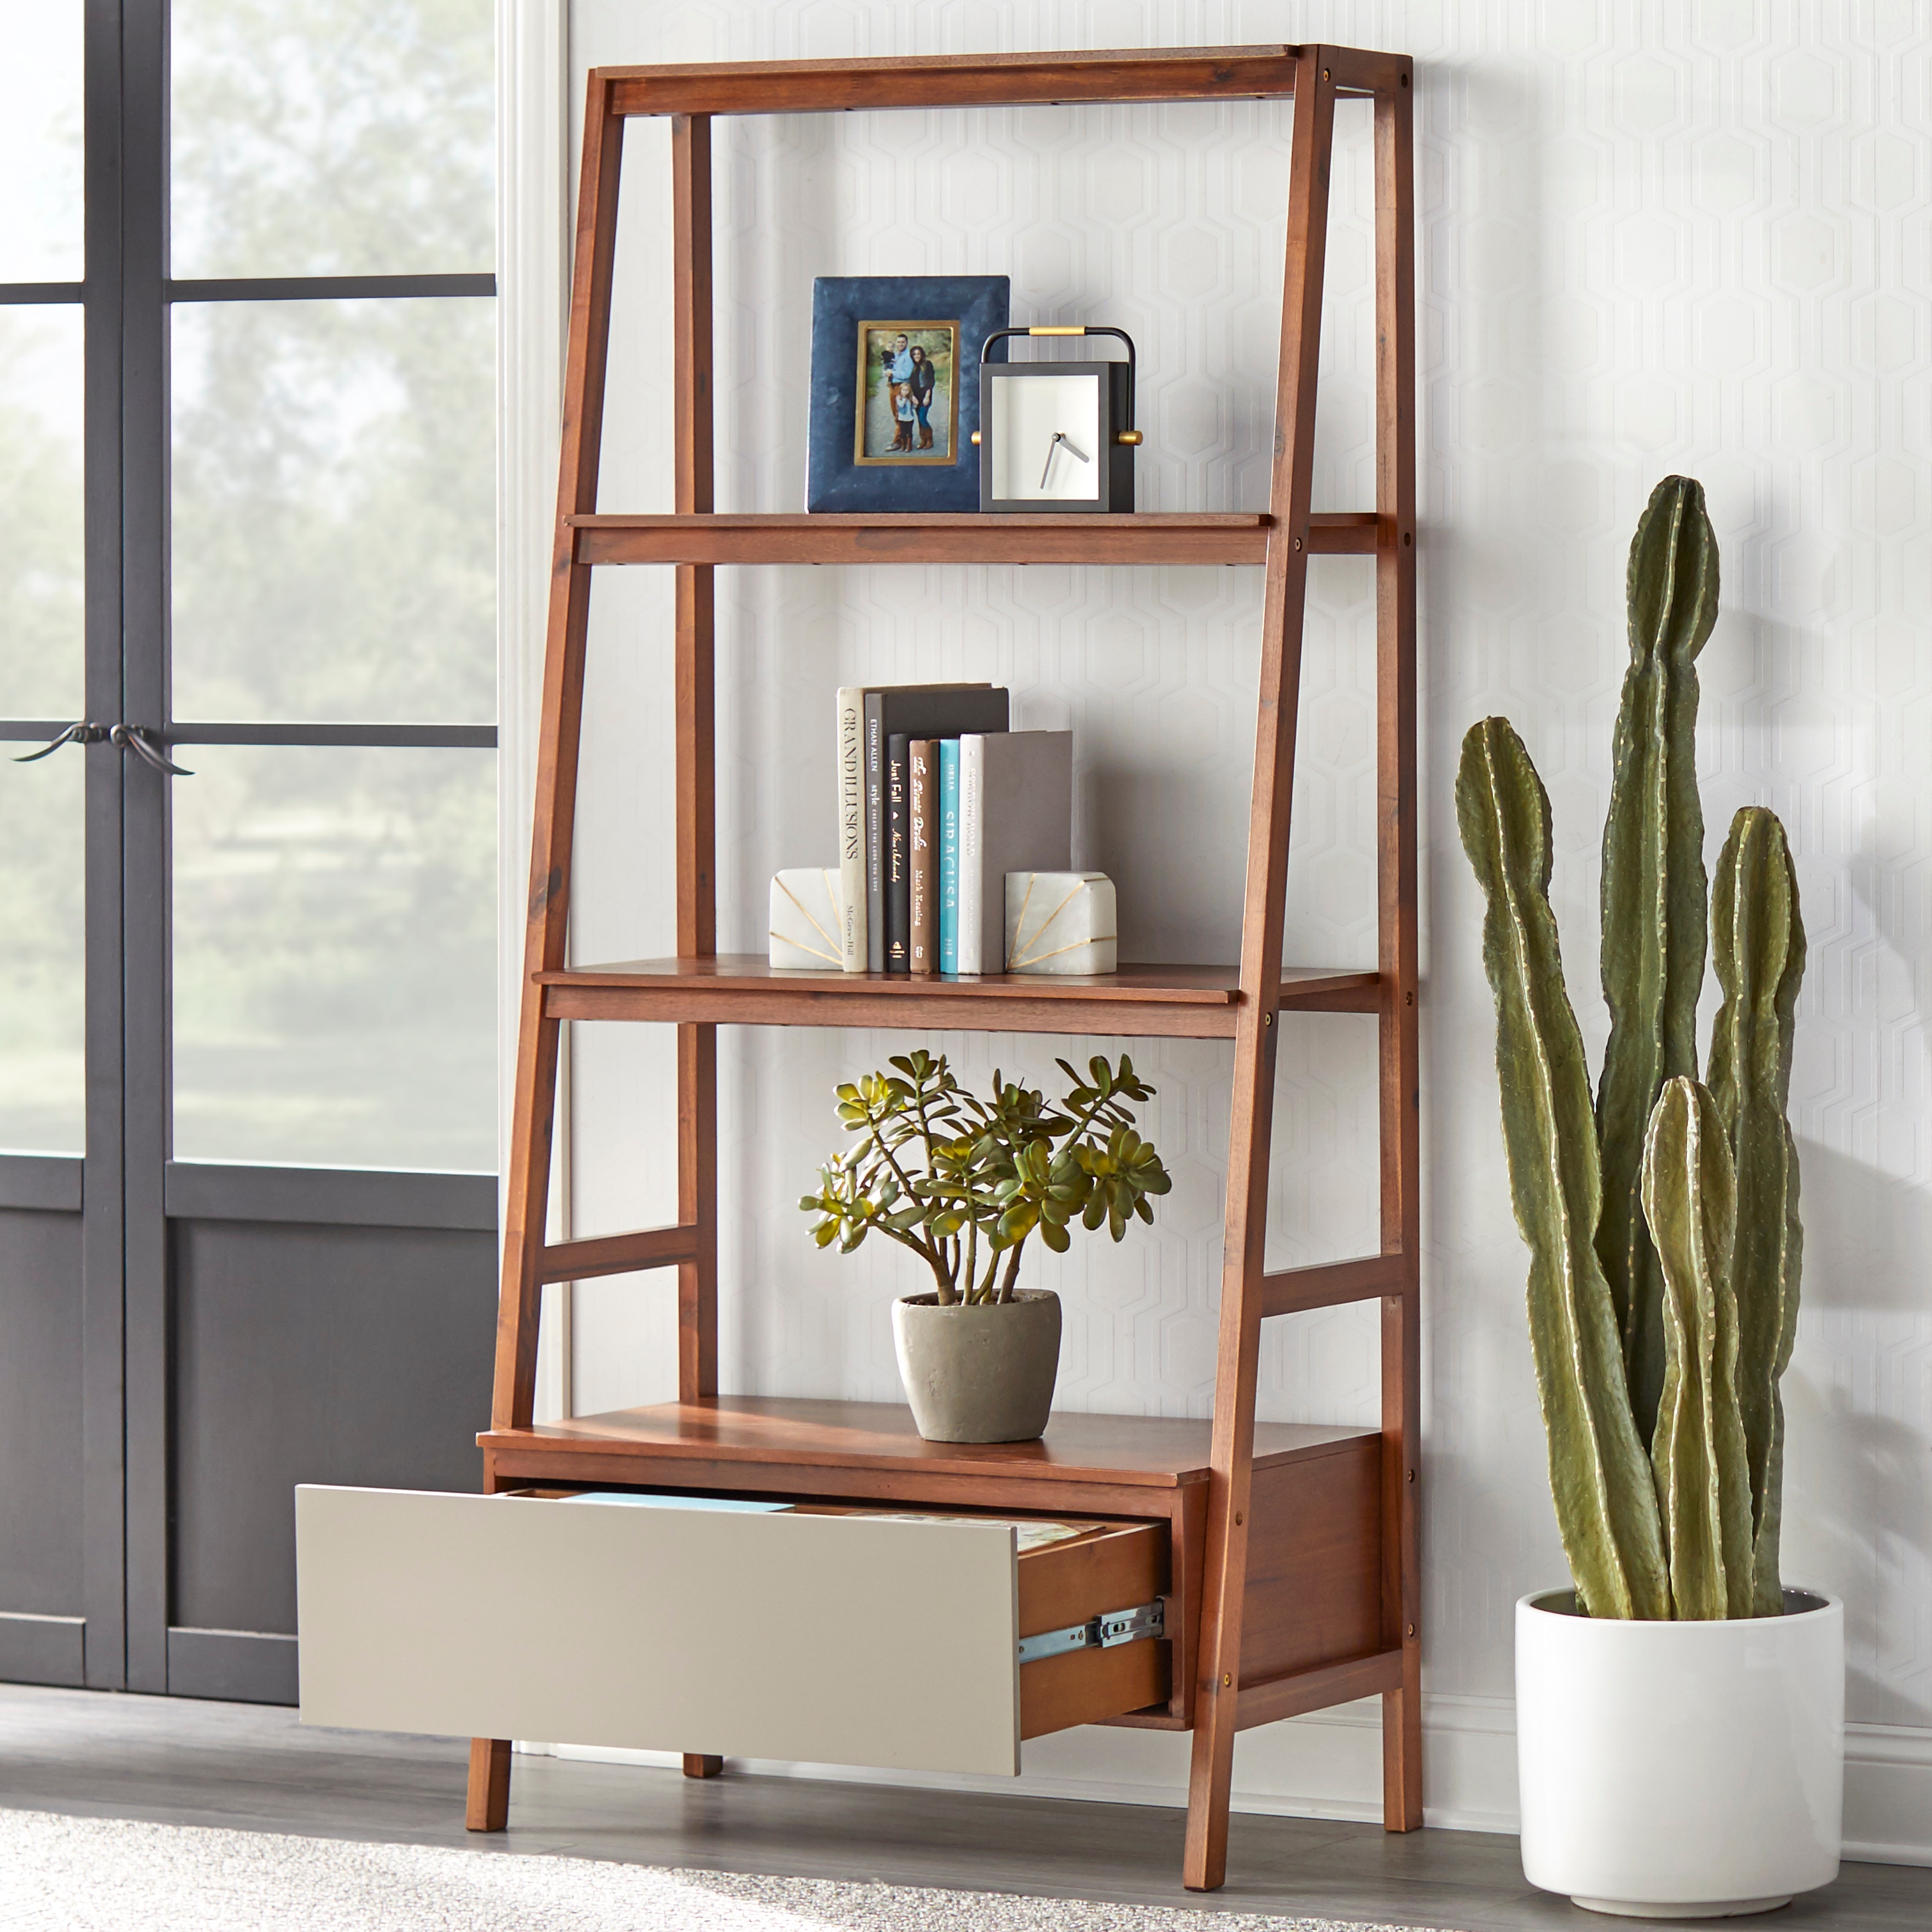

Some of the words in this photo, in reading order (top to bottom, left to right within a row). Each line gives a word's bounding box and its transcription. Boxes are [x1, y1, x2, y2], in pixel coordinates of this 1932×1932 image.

[843, 708, 857, 772] GRAND
[891, 760, 902, 781] Just
[914, 756, 927, 776] The
[869, 784, 880, 806] style
[891, 784, 902, 803] Fall
[914, 779, 923, 814] Pirate
[967, 767, 976, 820] SORROW
[845, 776, 858, 860] ILLUSIONS
[966, 823, 975, 857] ROAD
[943, 811, 955, 908] SIRACUSA
[915, 869, 923, 892] Mark
[914, 894, 923, 927] Keating
